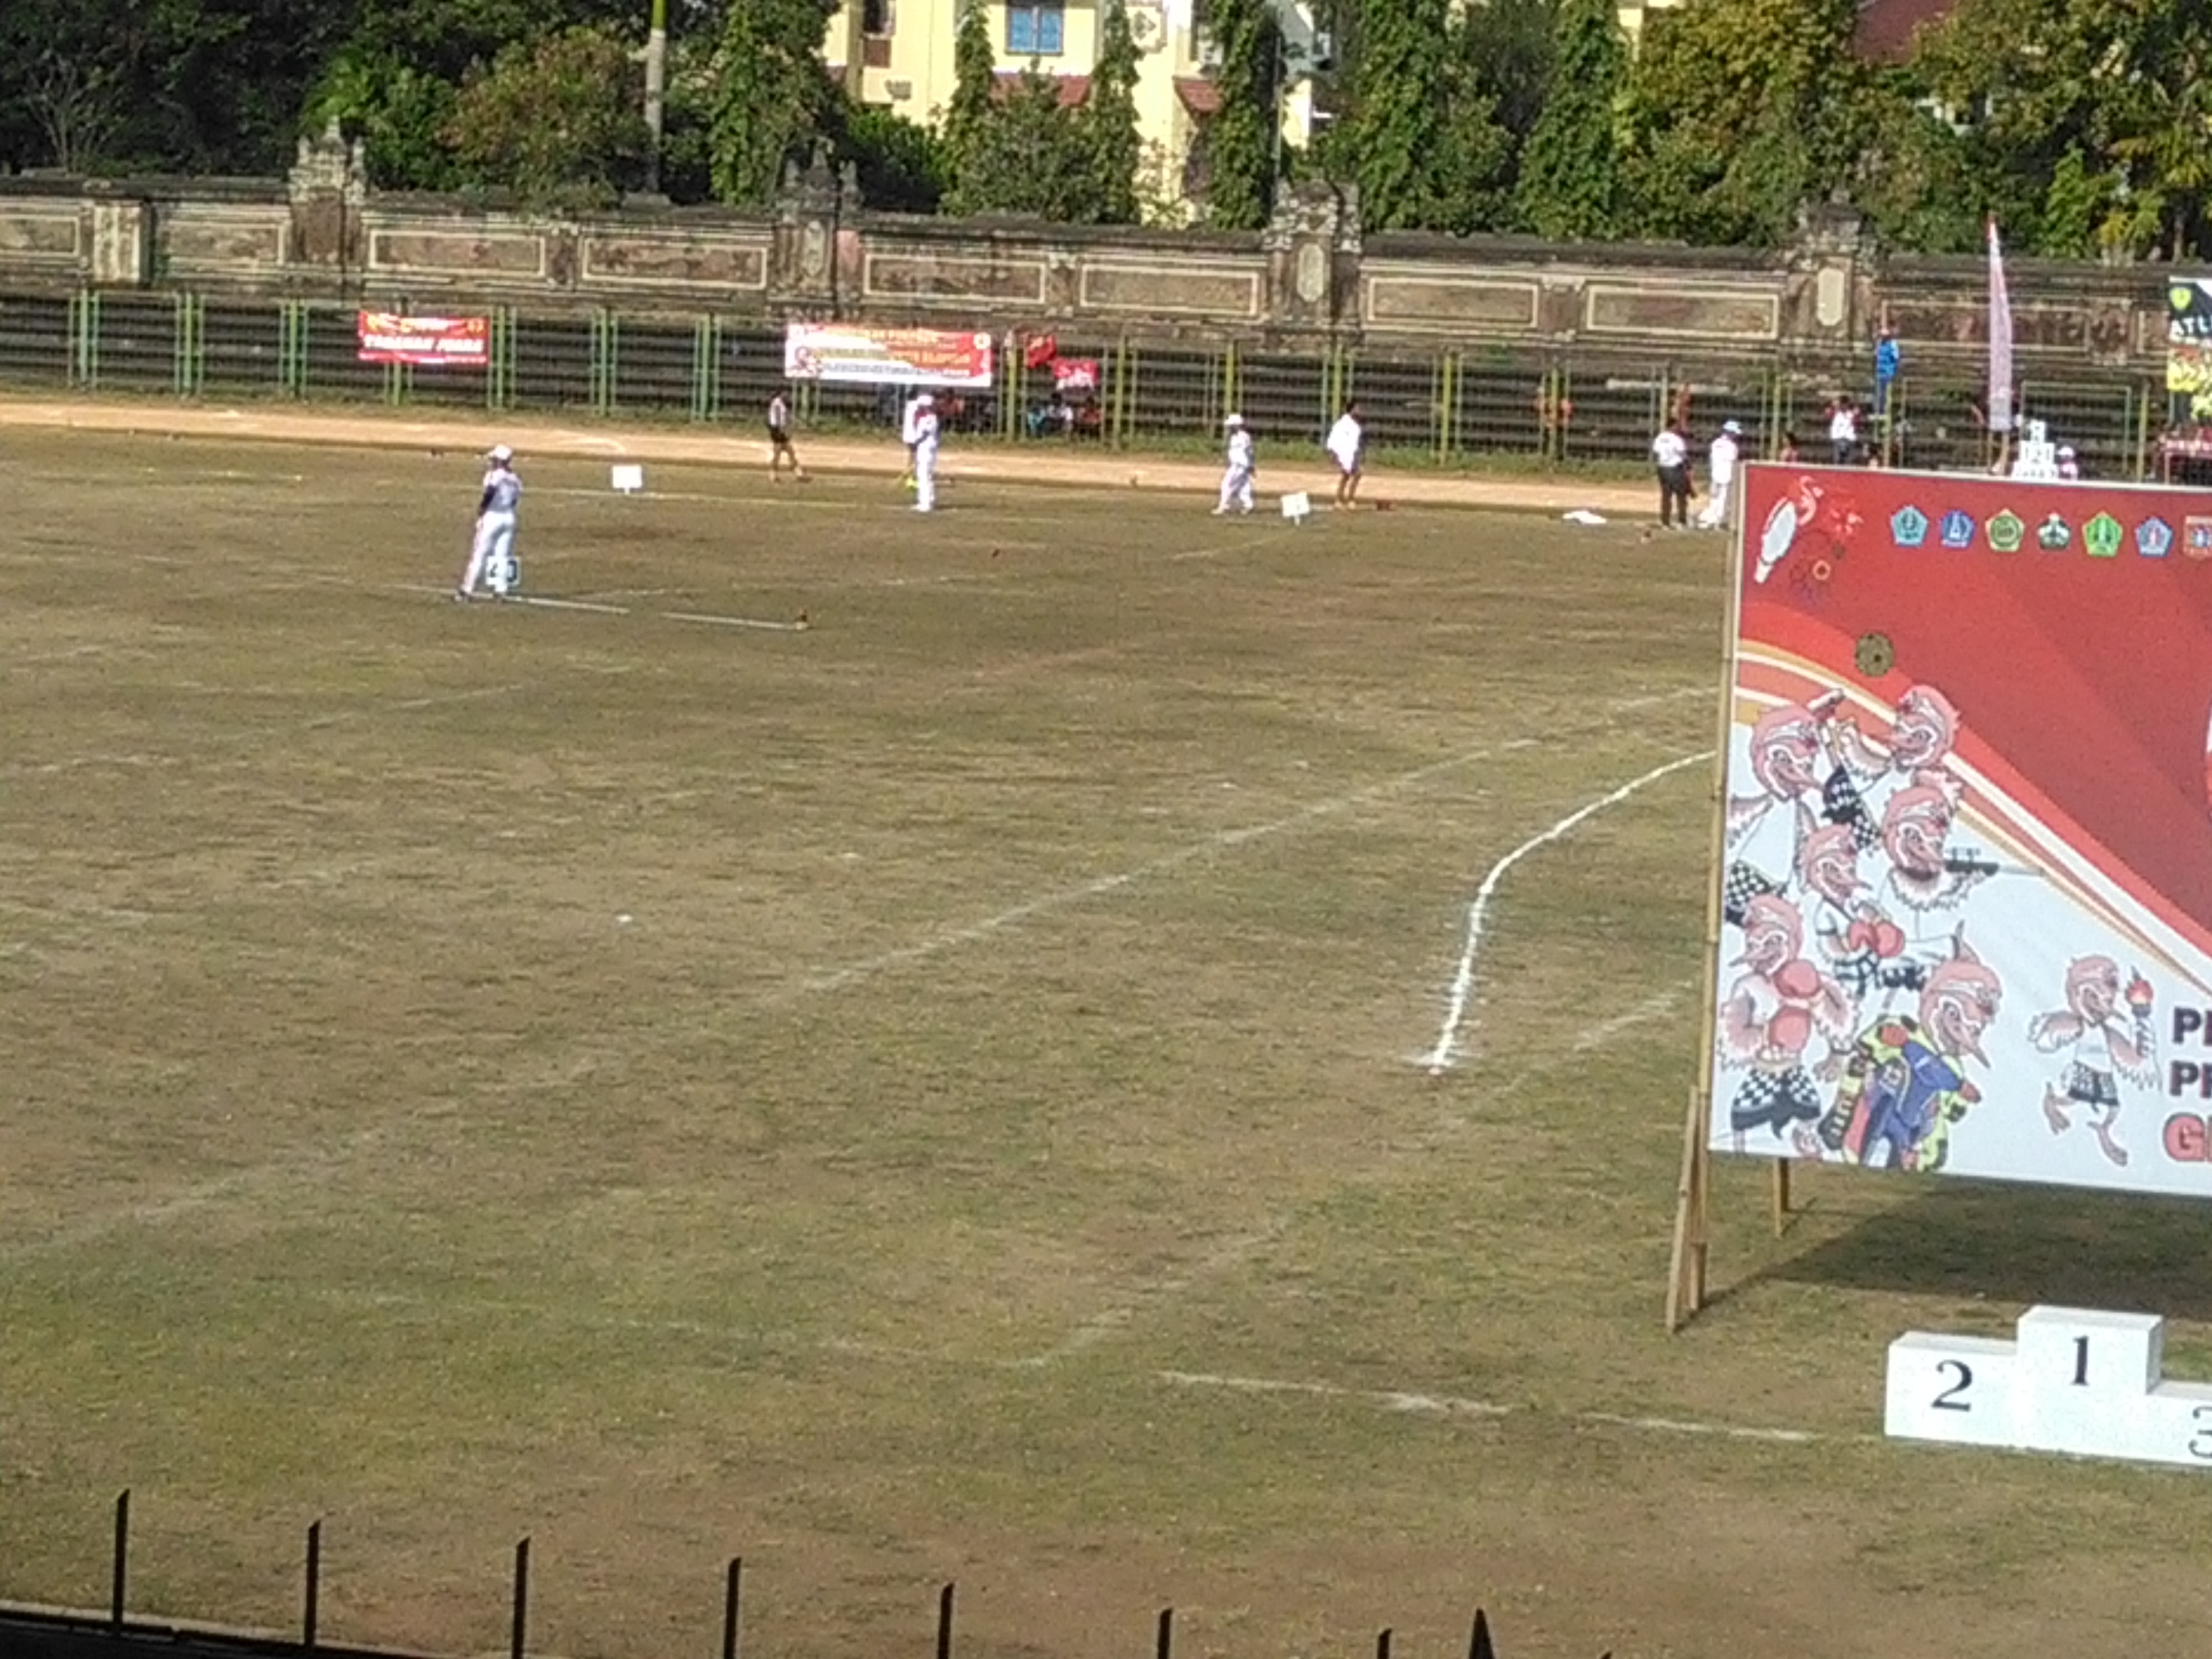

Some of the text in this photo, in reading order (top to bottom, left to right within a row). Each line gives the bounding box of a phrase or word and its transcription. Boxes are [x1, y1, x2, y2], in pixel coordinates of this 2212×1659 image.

[2171, 316, 2212, 335] ATL
[2172, 1006, 2212, 1046] P
[2163, 1111, 2212, 1162] G
[1931, 1359, 1973, 1412] 2
[2070, 1334, 2090, 1387] 1
[2188, 1405, 2212, 1458] 3
